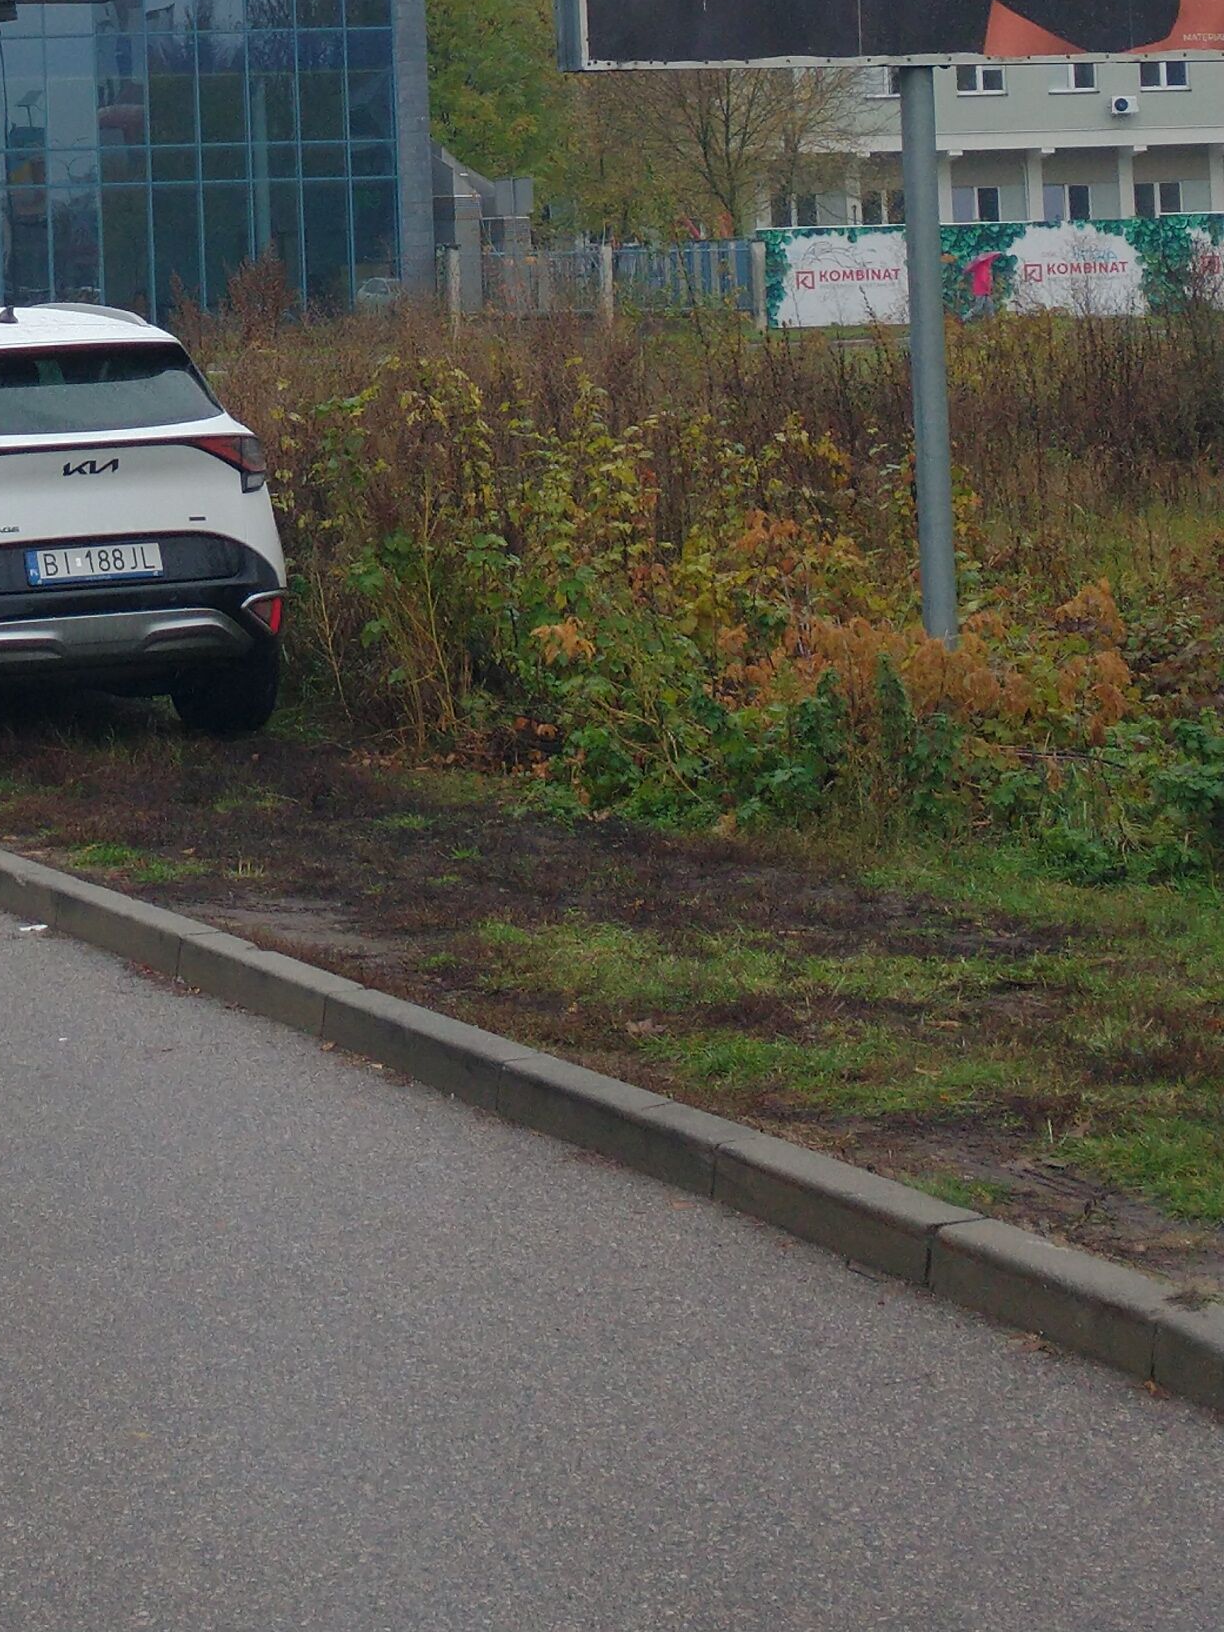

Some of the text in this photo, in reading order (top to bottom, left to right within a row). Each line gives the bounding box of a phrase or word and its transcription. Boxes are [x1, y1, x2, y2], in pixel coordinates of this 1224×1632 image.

[819, 268, 901, 282] KOMBINAT
[1047, 261, 1128, 275] KOMBINAT
[43, 546, 155, 576] BI 188JL
